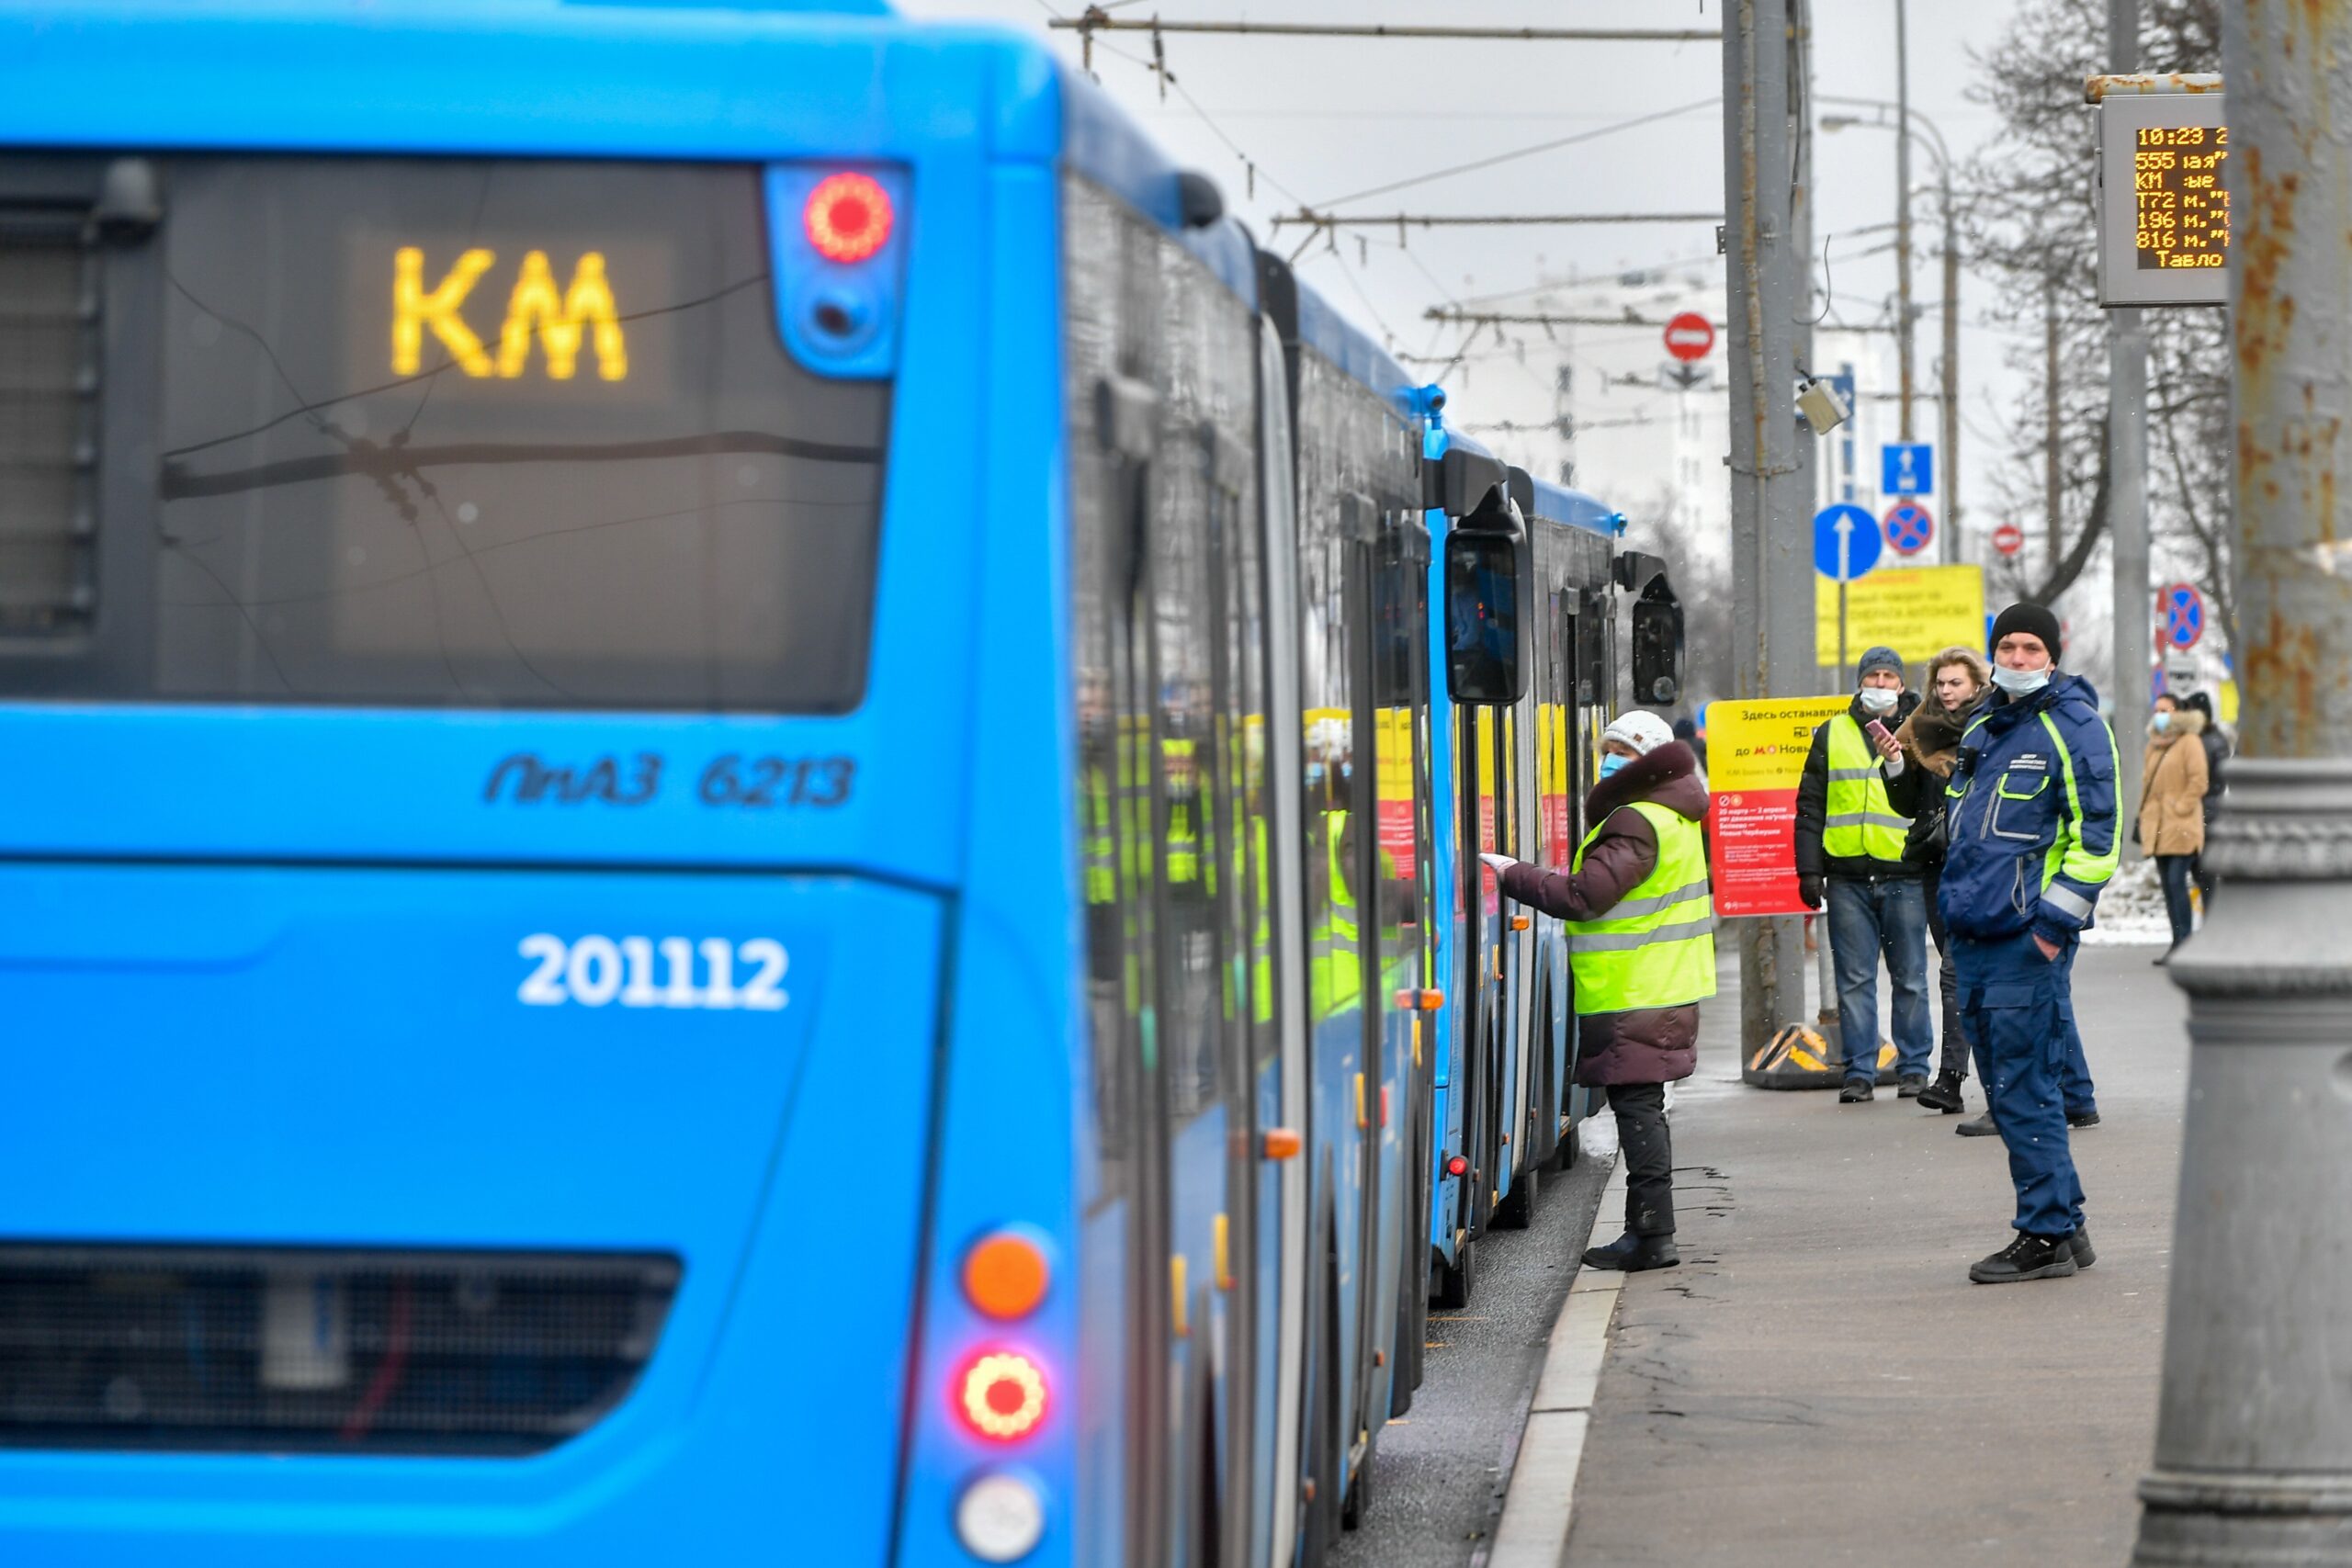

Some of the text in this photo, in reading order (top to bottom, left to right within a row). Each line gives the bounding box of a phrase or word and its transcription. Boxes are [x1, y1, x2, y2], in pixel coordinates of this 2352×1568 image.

[2138, 127, 2204, 145] 10:23
[2135, 151, 2176, 170] 555
[2135, 171, 2164, 189] КМ
[2135, 191, 2176, 209] Т72
[2138, 210, 2177, 229] 196
[2135, 230, 2177, 248] 816
[2155, 250, 2222, 267] Табло
[391, 246, 628, 380] КМ
[1742, 707, 1850, 721] Здесь останавлив
[1736, 748, 1749, 757] до
[698, 752, 858, 807] 6213
[517, 932, 789, 1011] 201112
